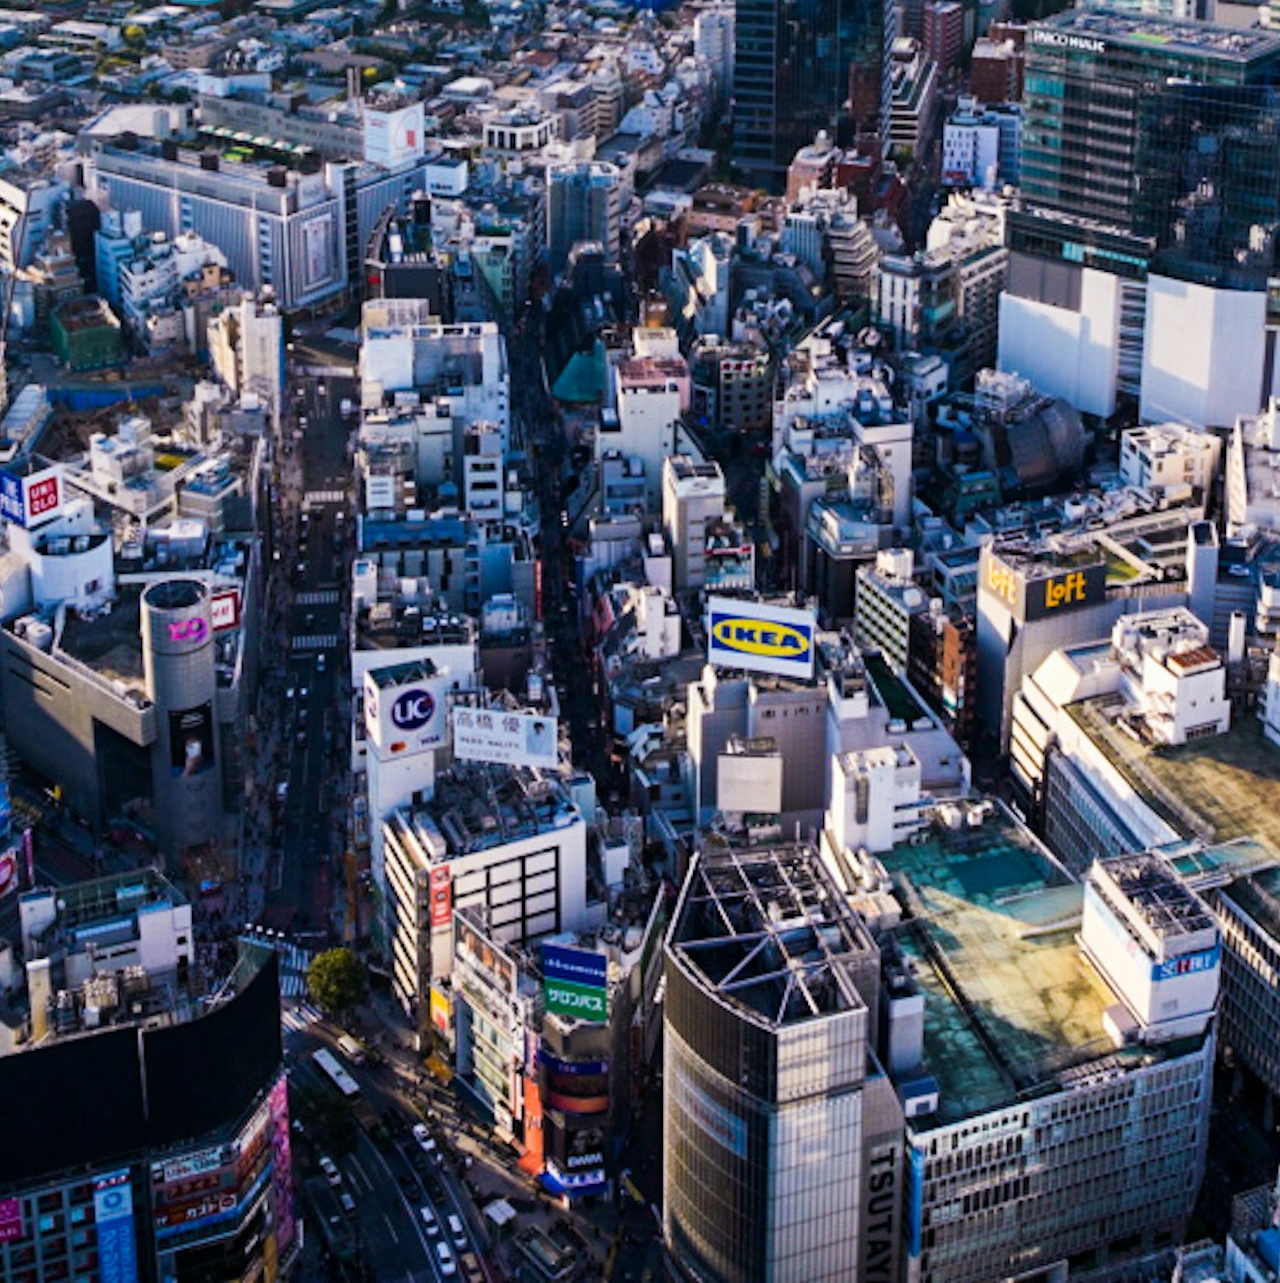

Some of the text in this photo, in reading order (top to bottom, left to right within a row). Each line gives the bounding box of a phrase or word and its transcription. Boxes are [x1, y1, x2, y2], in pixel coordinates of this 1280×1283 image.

[31, 481, 55, 500] UNI
[32, 494, 57, 514] QLO
[168, 617, 209, 644] 109
[721, 624, 801, 649] IKEA
[394, 698, 432, 724] UC
[548, 988, 604, 1013] サロンパス
[865, 1147, 895, 1283] TSUTAY
